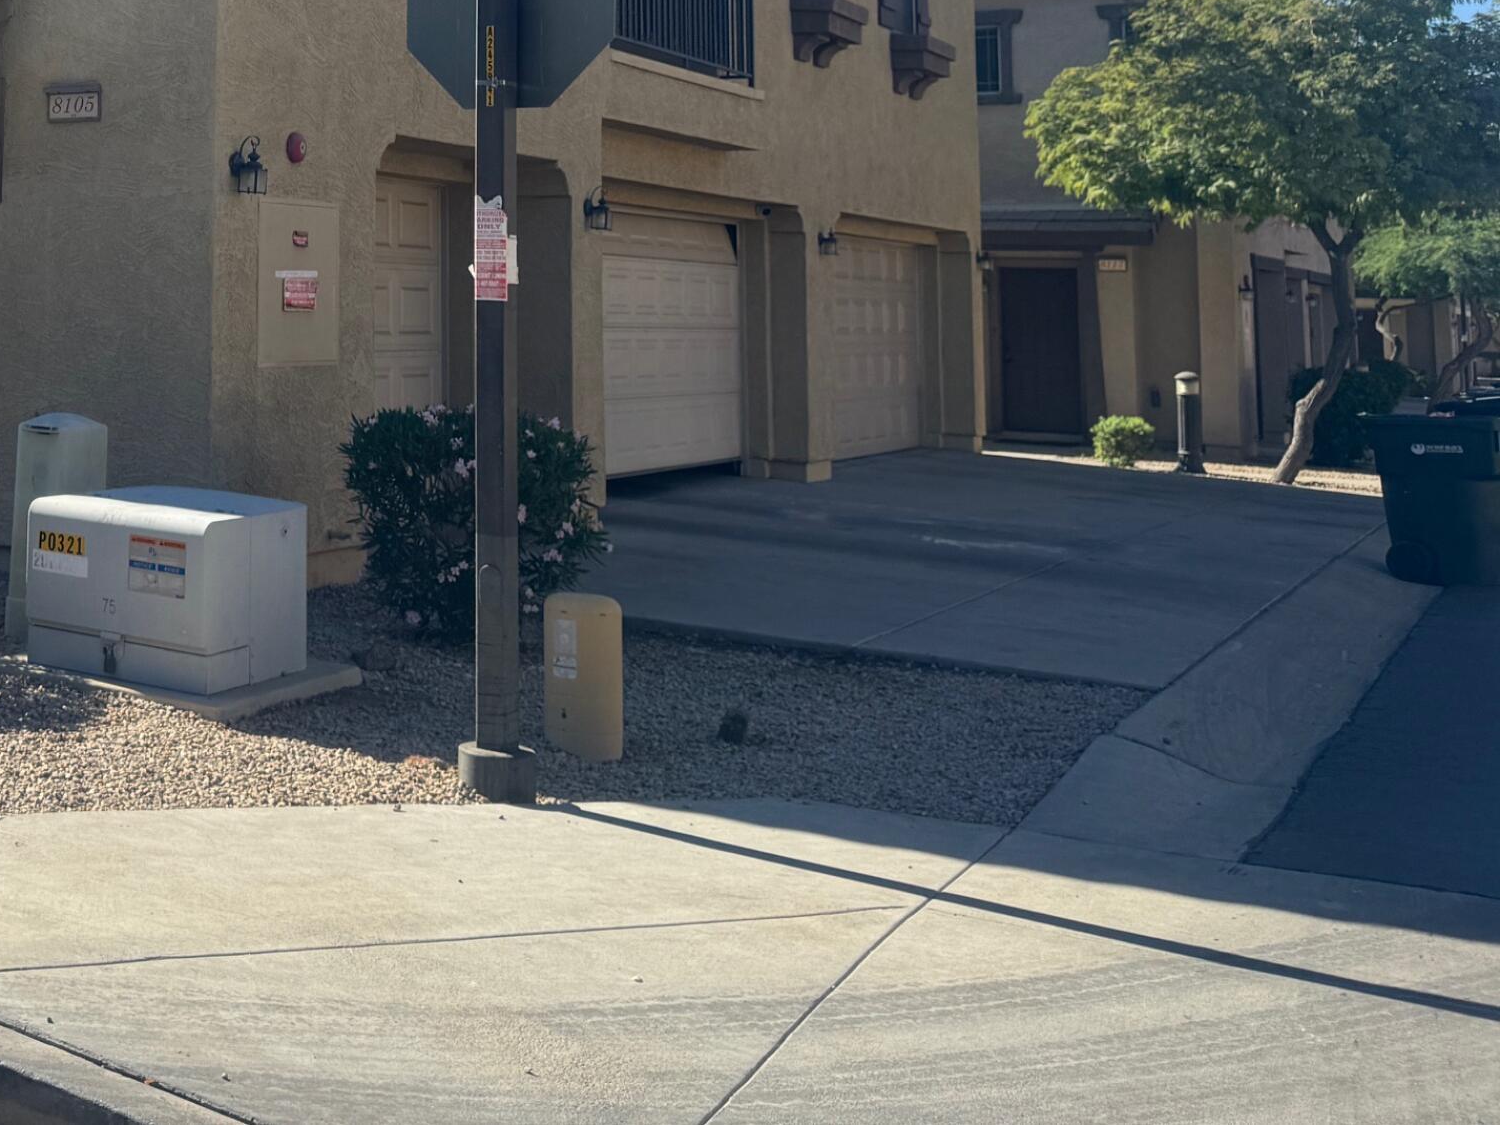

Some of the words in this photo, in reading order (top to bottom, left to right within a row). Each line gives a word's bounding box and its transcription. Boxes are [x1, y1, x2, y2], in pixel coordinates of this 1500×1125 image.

[52, 96, 95, 115] 8105
[38, 531, 83, 555] P0321
[102, 597, 116, 615] 75
